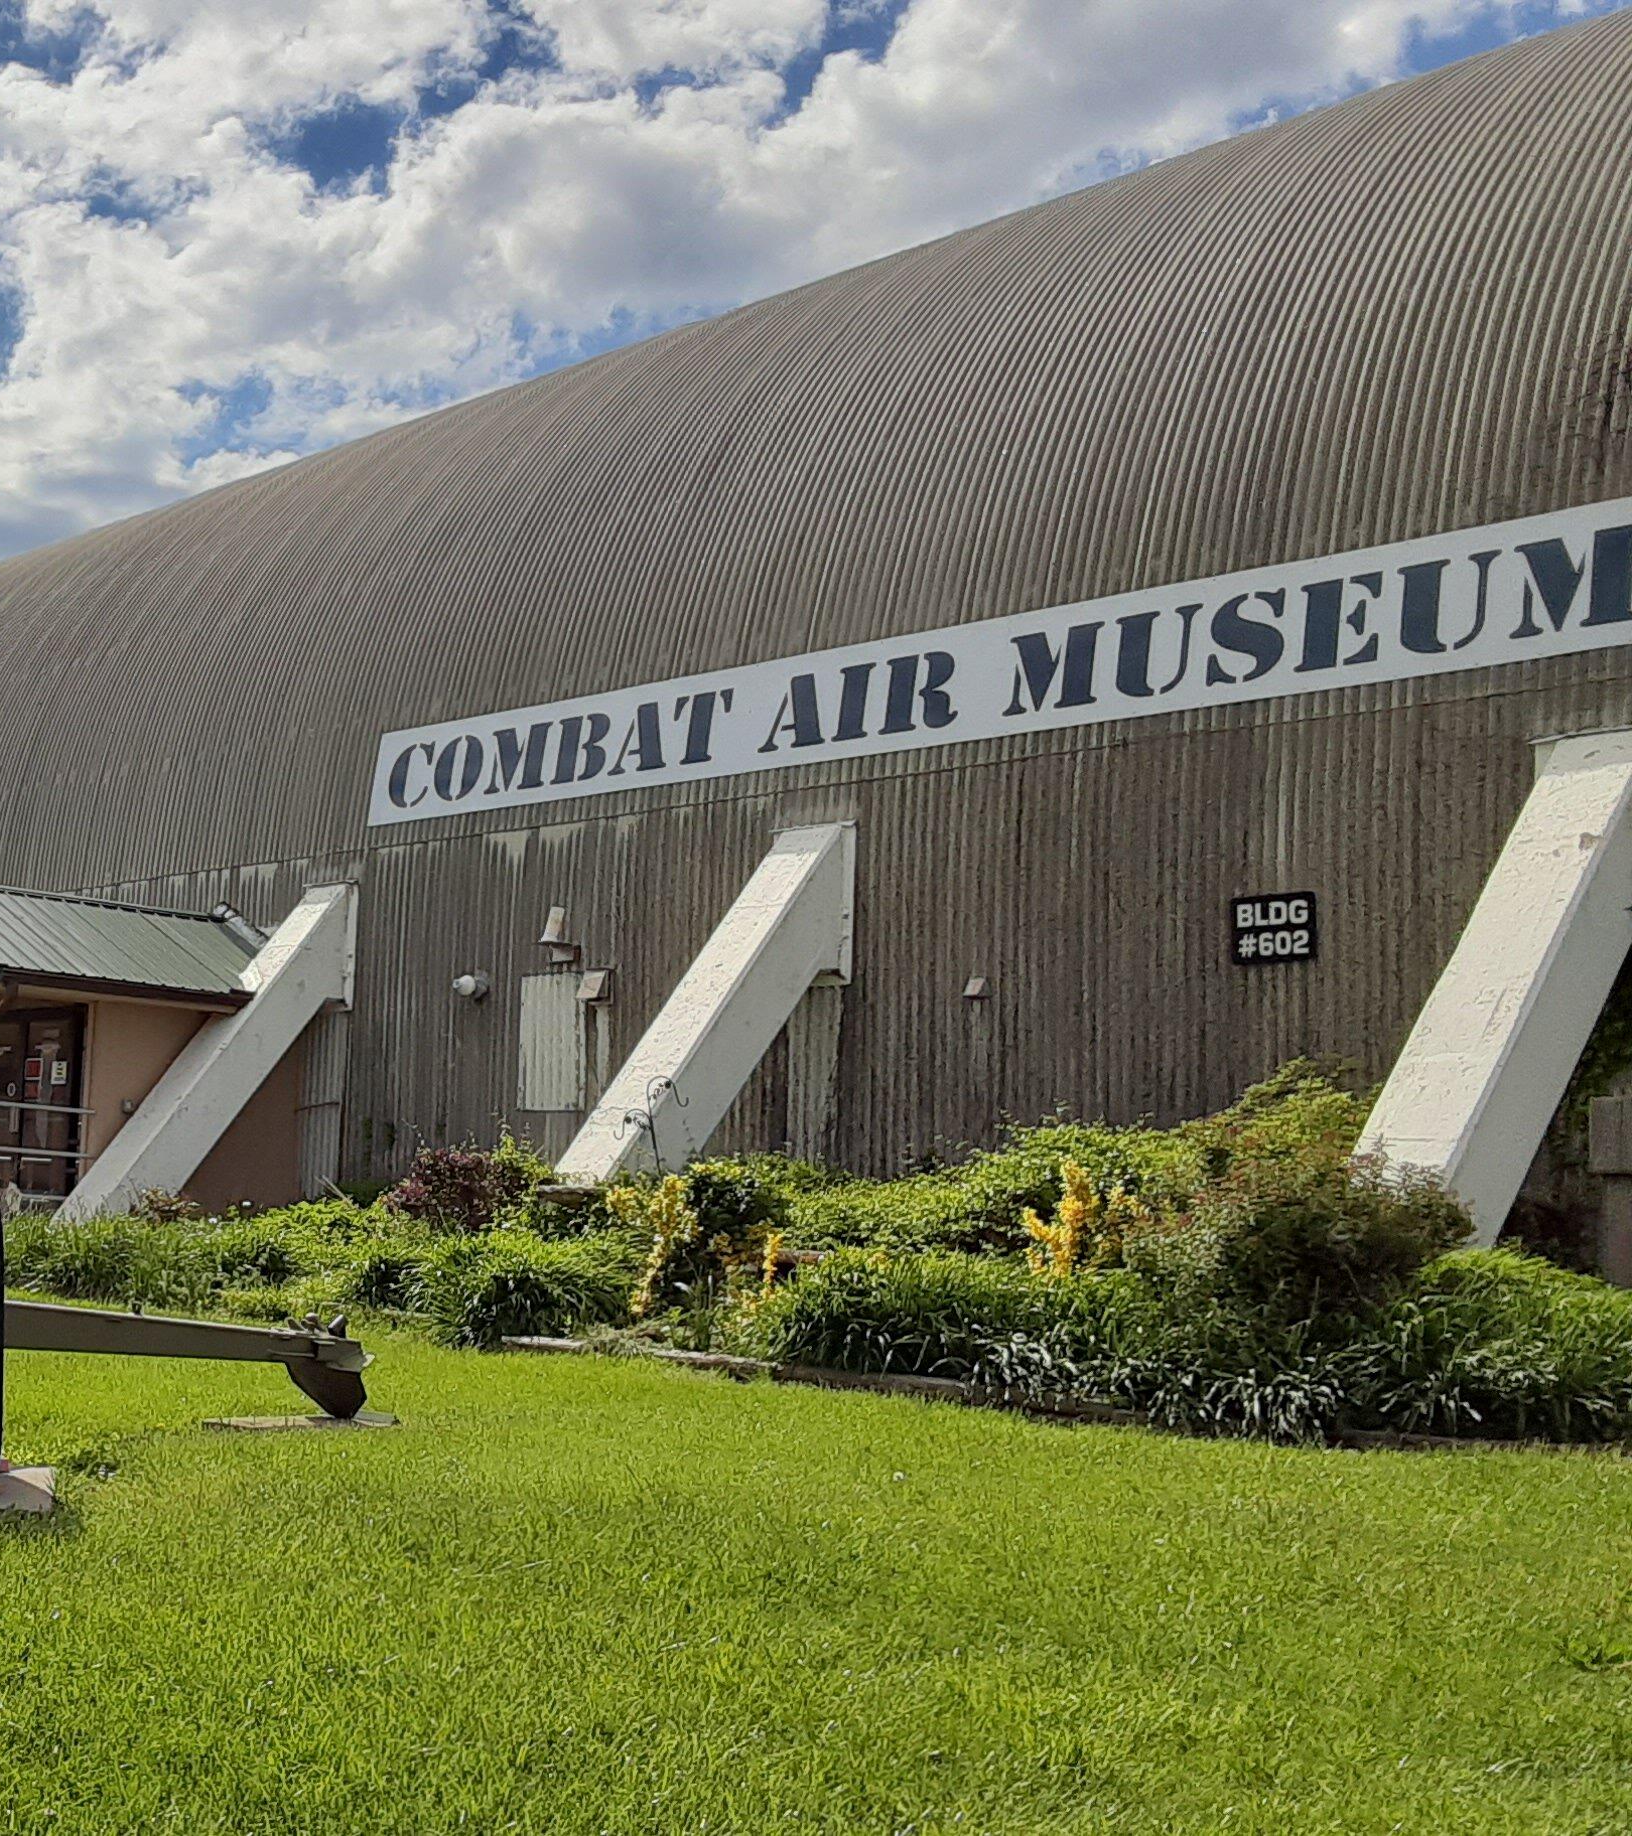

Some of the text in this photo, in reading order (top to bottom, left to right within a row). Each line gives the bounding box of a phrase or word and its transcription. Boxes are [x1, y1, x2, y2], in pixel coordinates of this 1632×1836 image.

[388, 525, 1632, 810] COMBAT AIR MUSEUM
[1236, 899, 1309, 928] BLDG
[1237, 929, 1310, 958] #602
